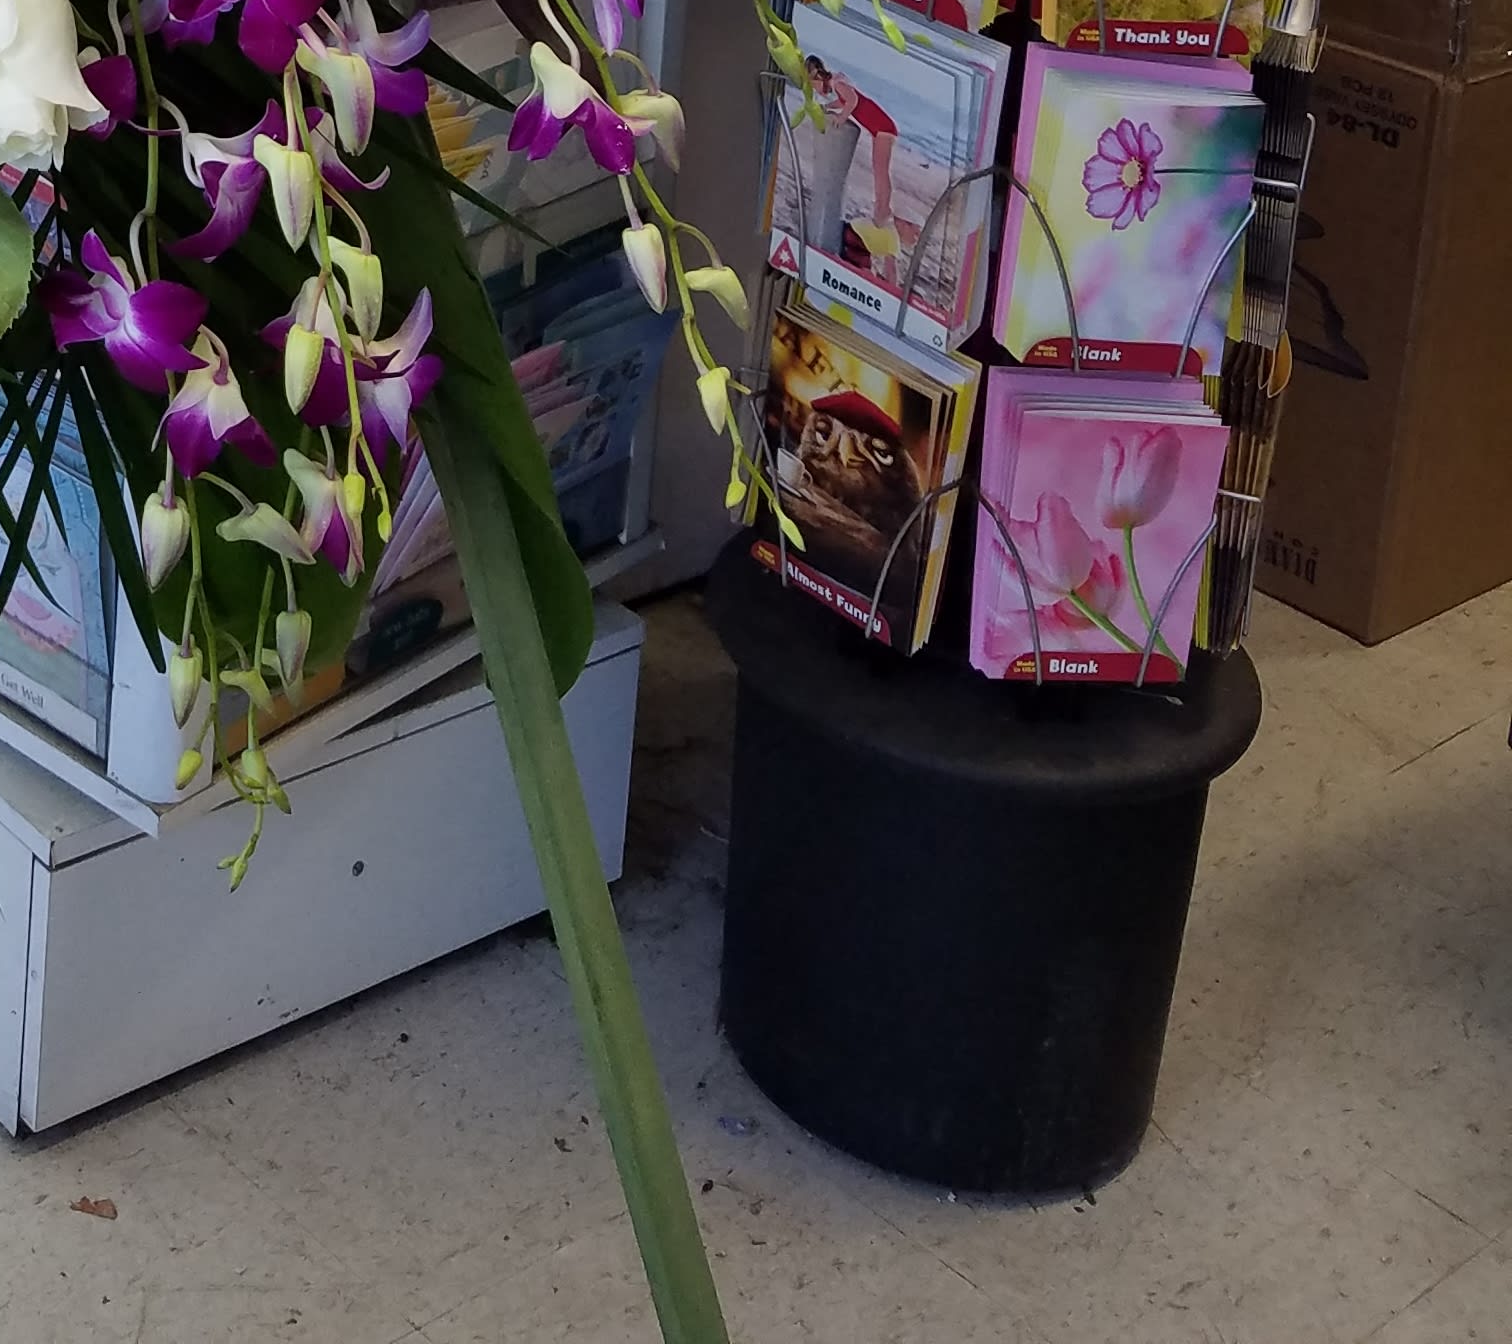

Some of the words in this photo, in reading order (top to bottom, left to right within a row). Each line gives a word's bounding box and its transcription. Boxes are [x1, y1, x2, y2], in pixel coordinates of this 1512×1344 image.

[1114, 28, 1171, 44] Thank
[1176, 30, 1210, 46] You
[821, 269, 882, 312] Romance
[786, 561, 833, 602] Almost
[1049, 658, 1098, 674] Blank
